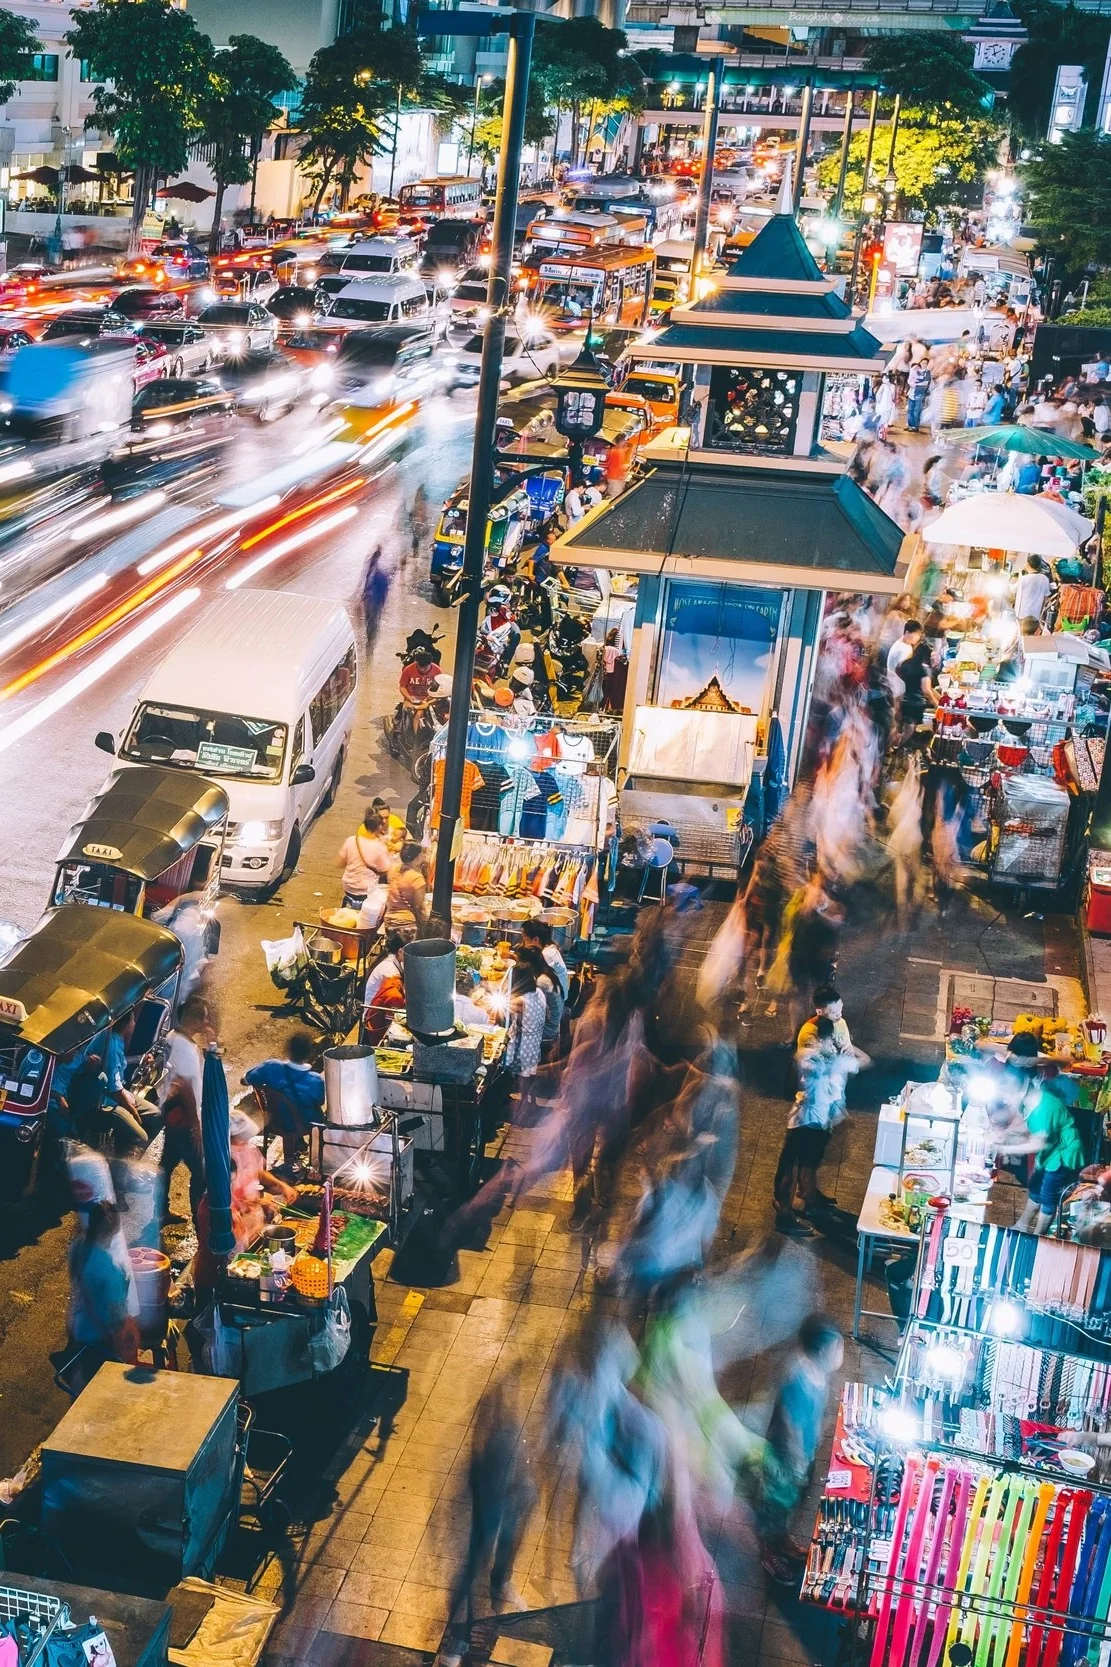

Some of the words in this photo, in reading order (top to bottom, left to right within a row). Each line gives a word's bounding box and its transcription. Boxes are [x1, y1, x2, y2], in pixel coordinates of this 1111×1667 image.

[789, 11, 830, 24] Bangkok
[91, 846, 113, 856] TAXI
[946, 1241, 973, 1260] 50
